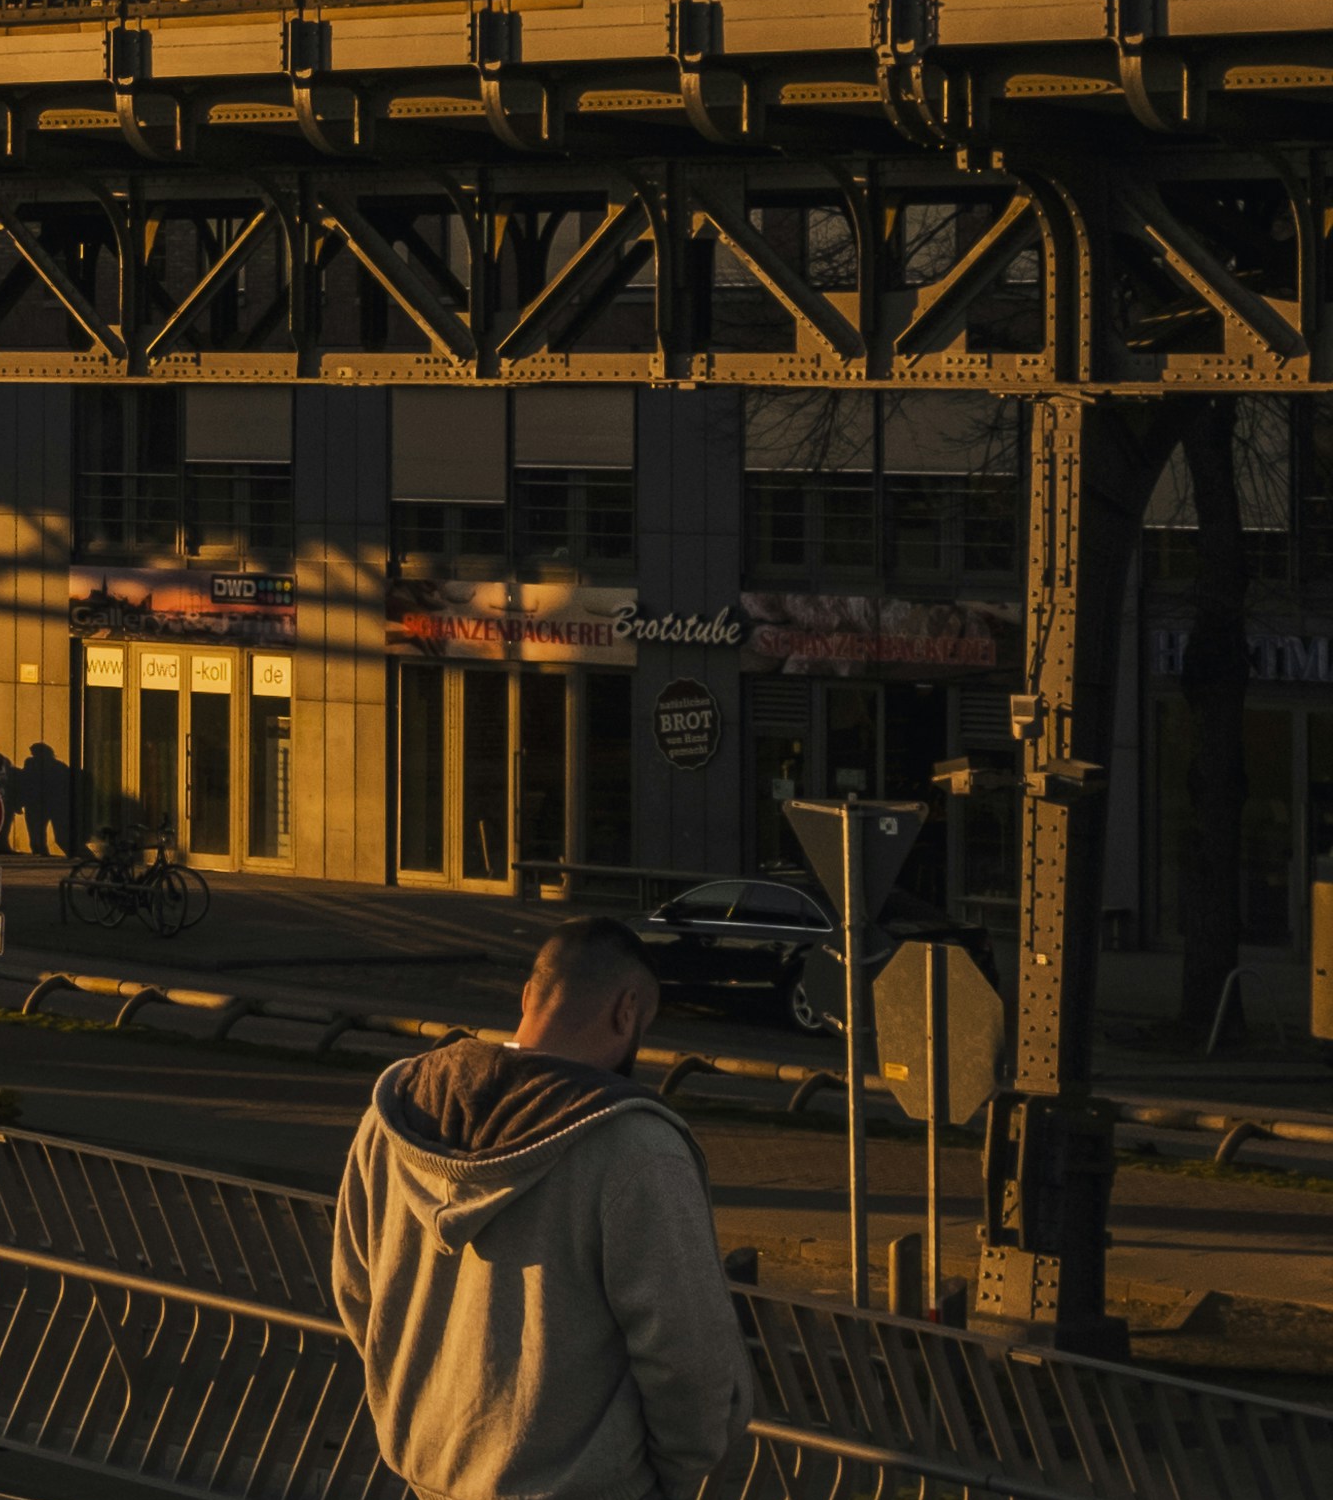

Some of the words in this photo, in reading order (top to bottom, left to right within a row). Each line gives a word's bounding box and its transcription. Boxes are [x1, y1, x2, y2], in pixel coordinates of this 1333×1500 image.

[213, 578, 257, 598] DWD
[71, 606, 166, 634] Gallery
[402, 611, 614, 647] SCHANZENBÄCKEREI
[611, 600, 742, 645] Brotstube
[759, 630, 997, 666] SCHANZENBÄCKEREI
[87, 659, 123, 674] www
[195, 662, 227, 681] -koll
[260, 664, 284, 684] .de
[660, 710, 712, 732] BROT
[684, 733, 708, 743] Hand
[668, 745, 708, 759] gemacht
